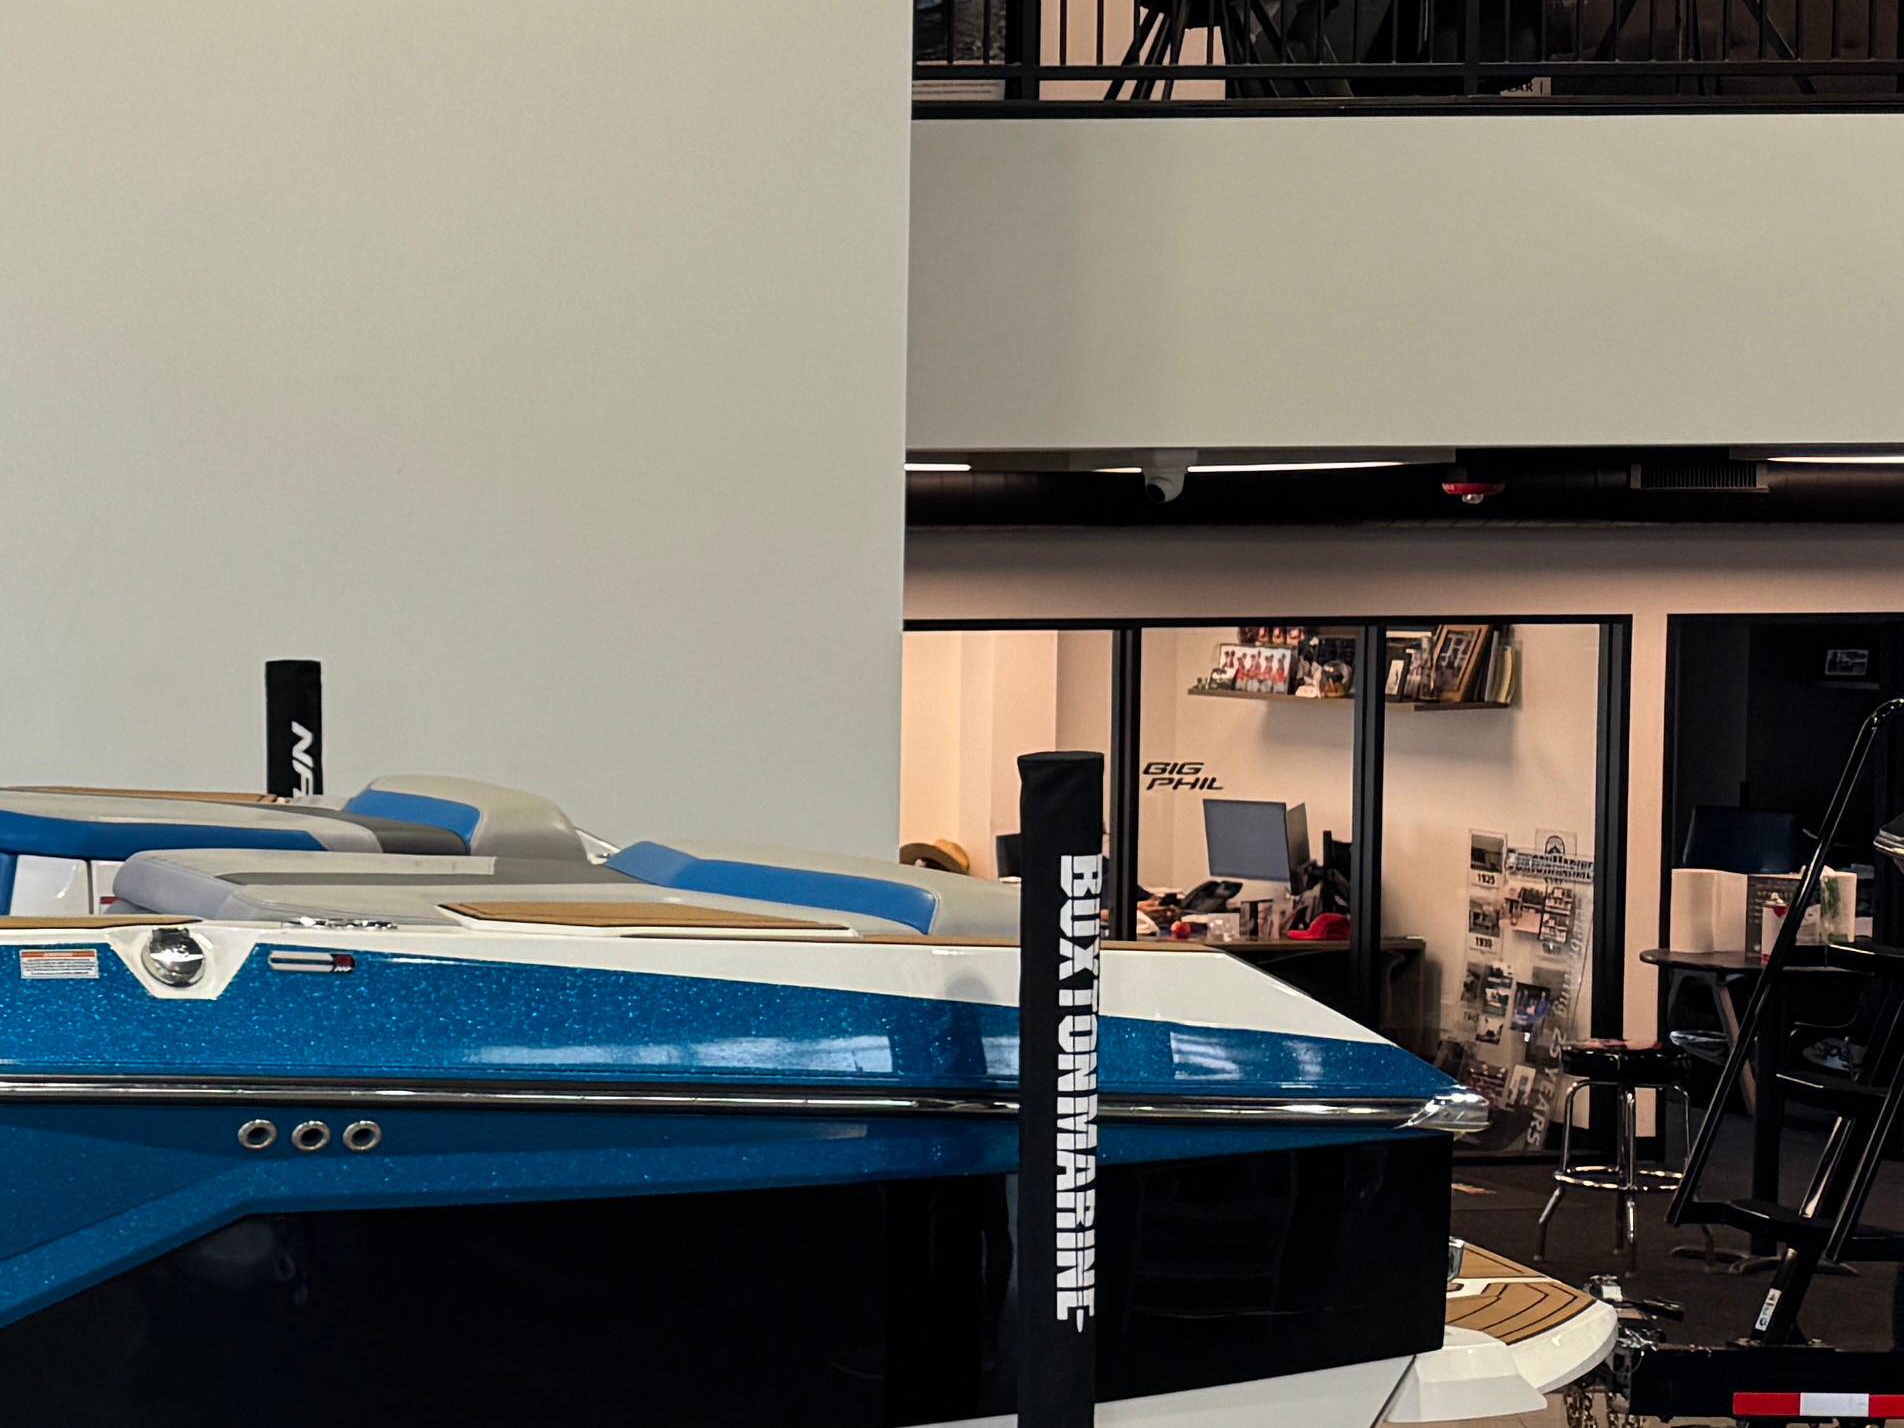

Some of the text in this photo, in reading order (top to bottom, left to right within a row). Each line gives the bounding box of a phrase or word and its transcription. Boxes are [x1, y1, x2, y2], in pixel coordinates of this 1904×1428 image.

[1143, 762, 1205, 775] BIG
[1146, 777, 1224, 790] PHIL
[1055, 853, 1103, 1321] BUXTONMARINE
[1527, 1067, 1561, 1148] YEARS
